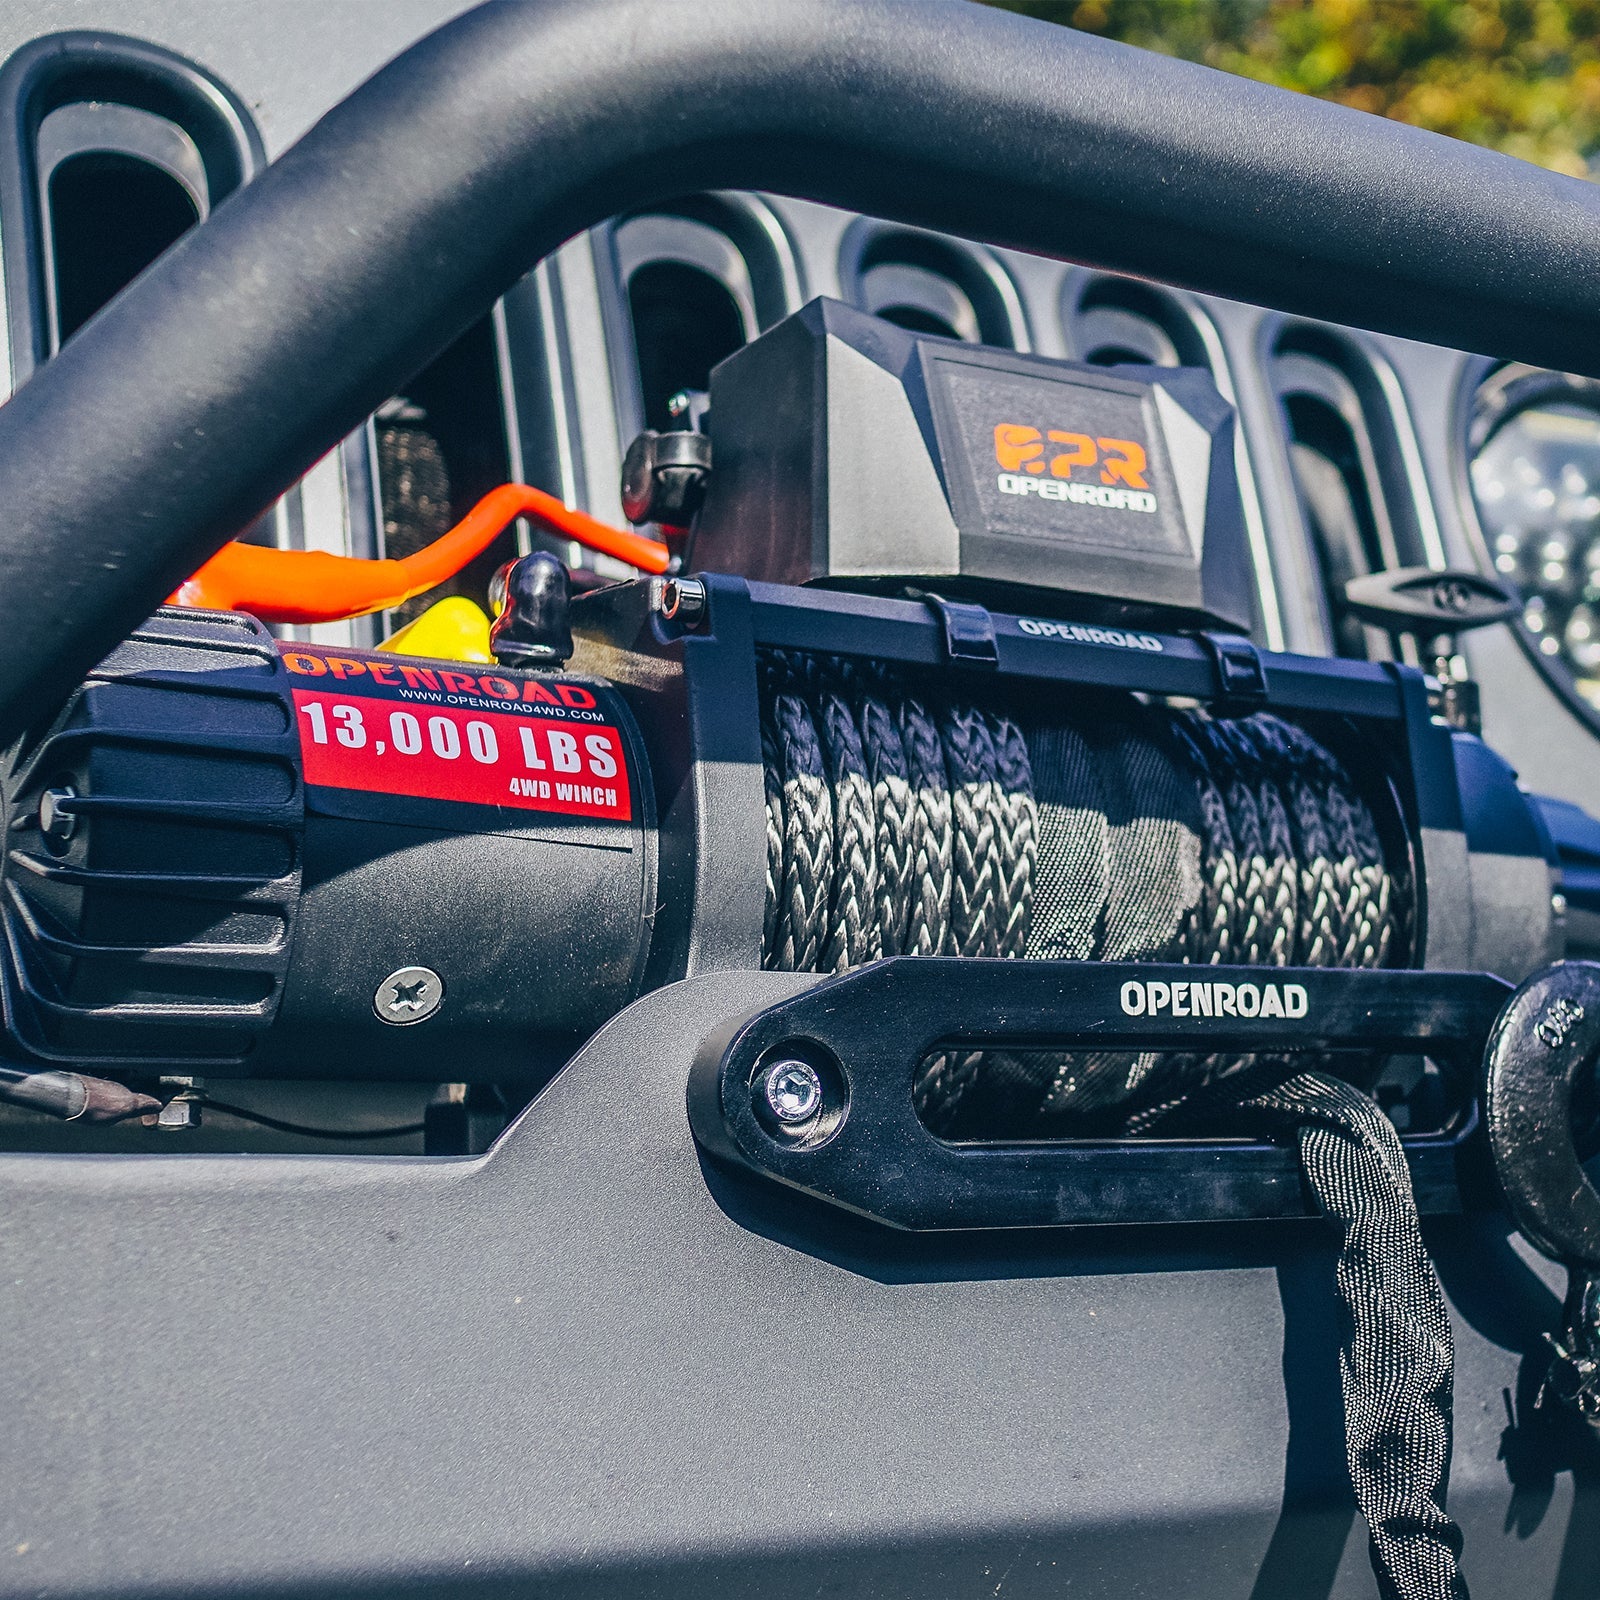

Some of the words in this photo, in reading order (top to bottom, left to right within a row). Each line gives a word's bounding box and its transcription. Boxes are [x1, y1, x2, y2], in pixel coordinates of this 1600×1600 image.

[998, 473, 1157, 513] OPENROAD
[1018, 618, 1163, 652] OPENROAD
[282, 652, 597, 709] OPENROAD
[398, 689, 605, 722] WWW.OPENROAD4WD.COM
[300, 701, 499, 764] 13,000
[519, 726, 618, 778] LBS
[509, 777, 551, 799] 4WD
[556, 784, 617, 807] WINCH
[1120, 980, 1308, 1019] OPENROAD
